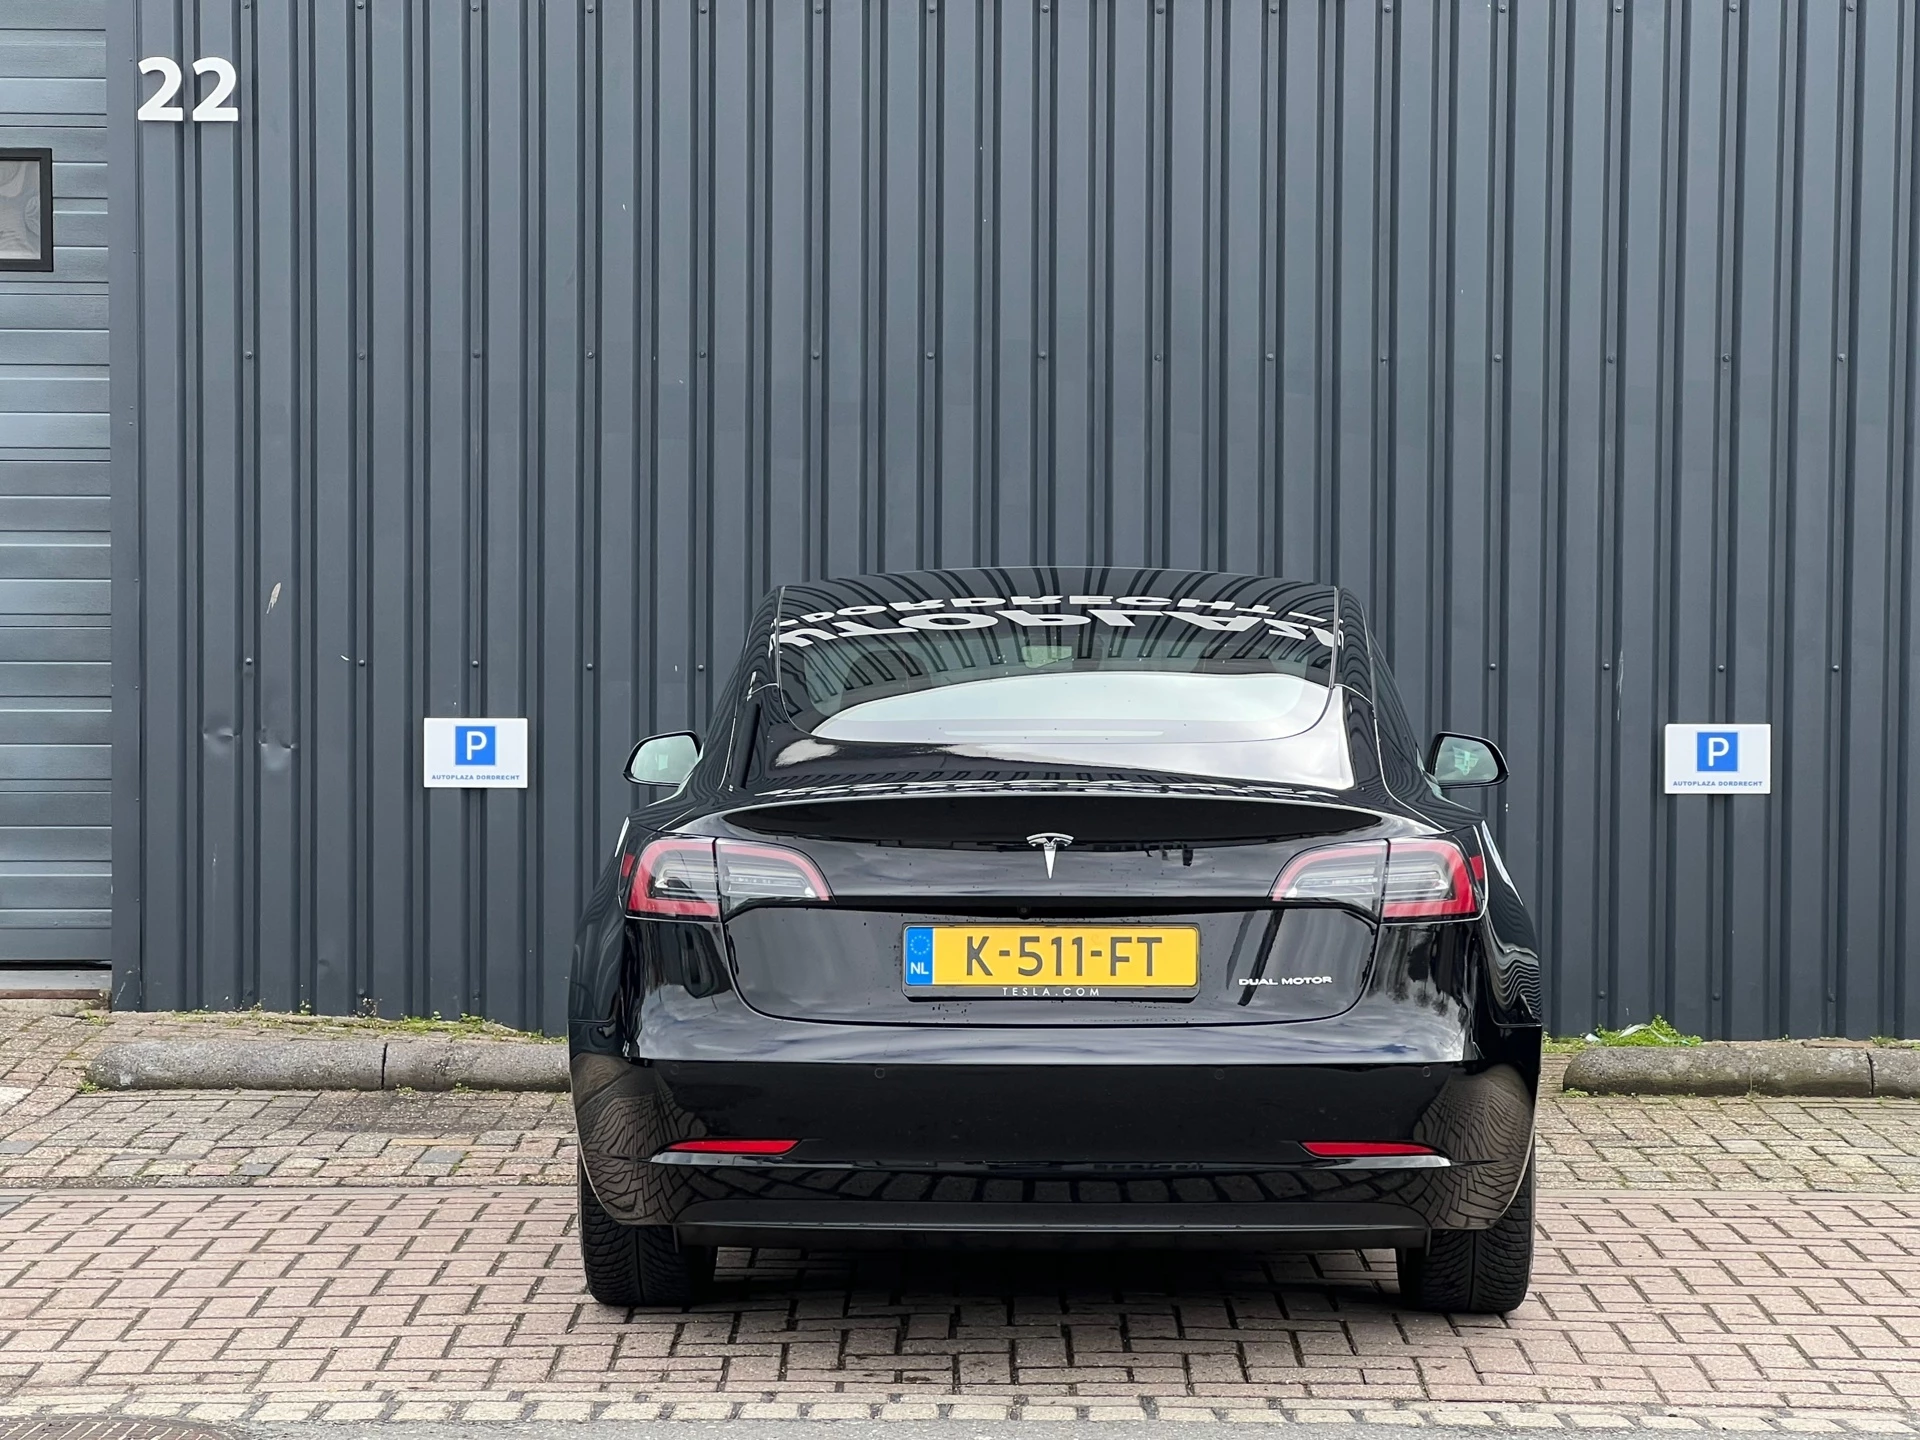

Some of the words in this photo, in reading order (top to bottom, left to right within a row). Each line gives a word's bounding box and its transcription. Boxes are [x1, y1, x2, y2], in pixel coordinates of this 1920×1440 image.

[138, 56, 239, 121] 22
[466, 730, 488, 761] P
[1708, 737, 1730, 767] P
[910, 961, 929, 975] NL
[965, 935, 1163, 977] K-511-FT
[1002, 987, 1100, 997] TESLA.COM
[1238, 978, 1279, 986] DUAL
[1281, 976, 1333, 985] MOTOR
